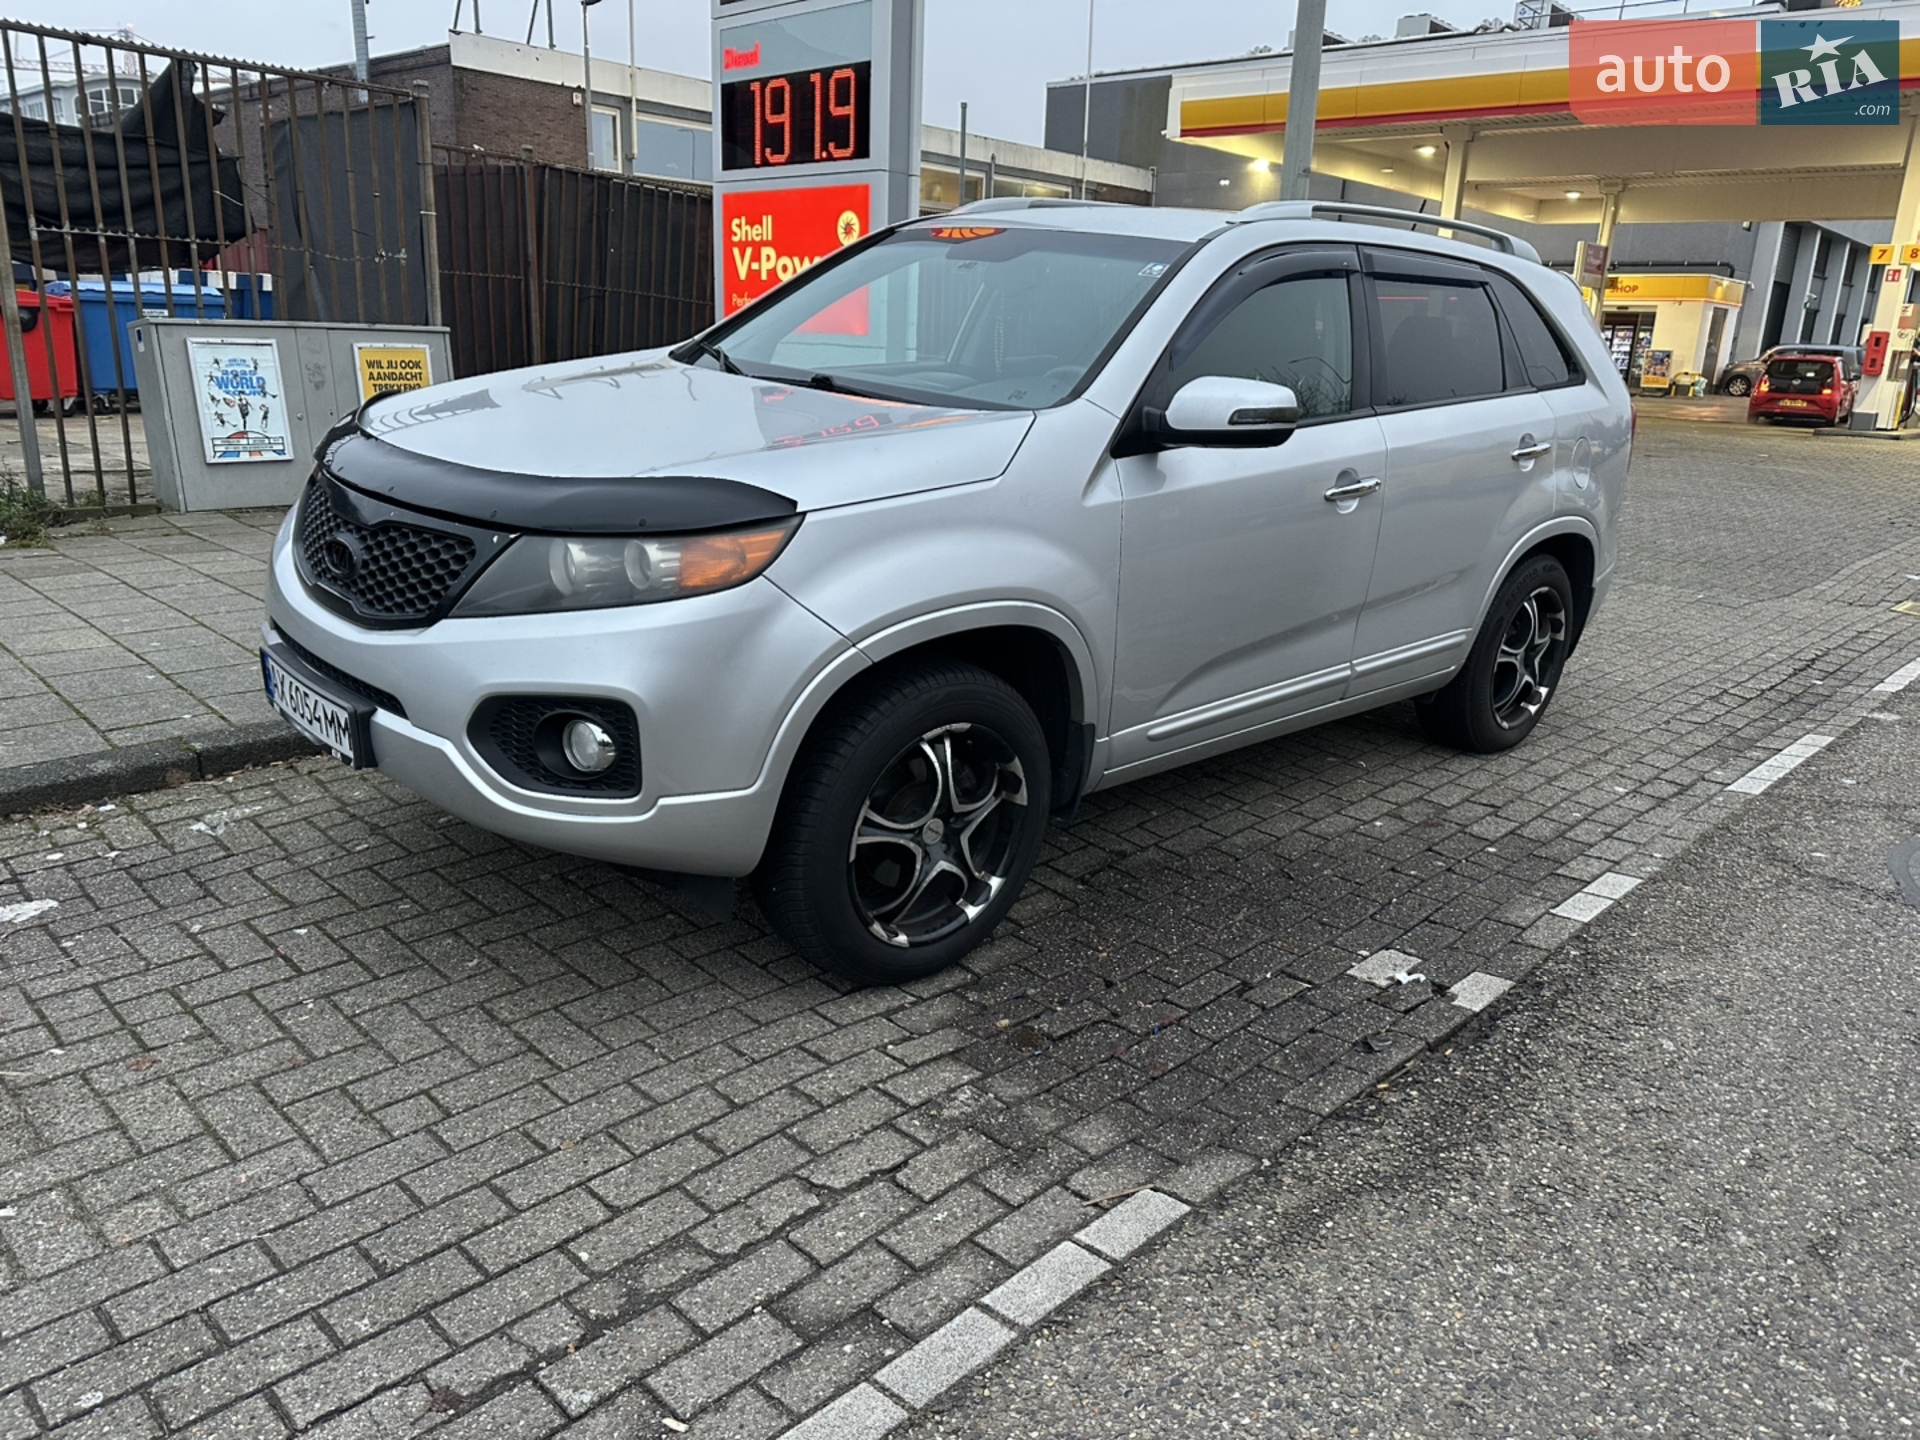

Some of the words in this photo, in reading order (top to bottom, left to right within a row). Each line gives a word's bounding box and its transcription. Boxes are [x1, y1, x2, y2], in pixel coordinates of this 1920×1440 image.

[724, 41, 761, 70] Diesel
[731, 215, 773, 242] Shell
[1878, 249, 1888, 260] 7
[1910, 248, 1920, 259] 8
[365, 359, 384, 369] WIL
[399, 359, 422, 370] OOK
[368, 371, 423, 381] AANDACHT
[215, 376, 266, 389] WORLD
